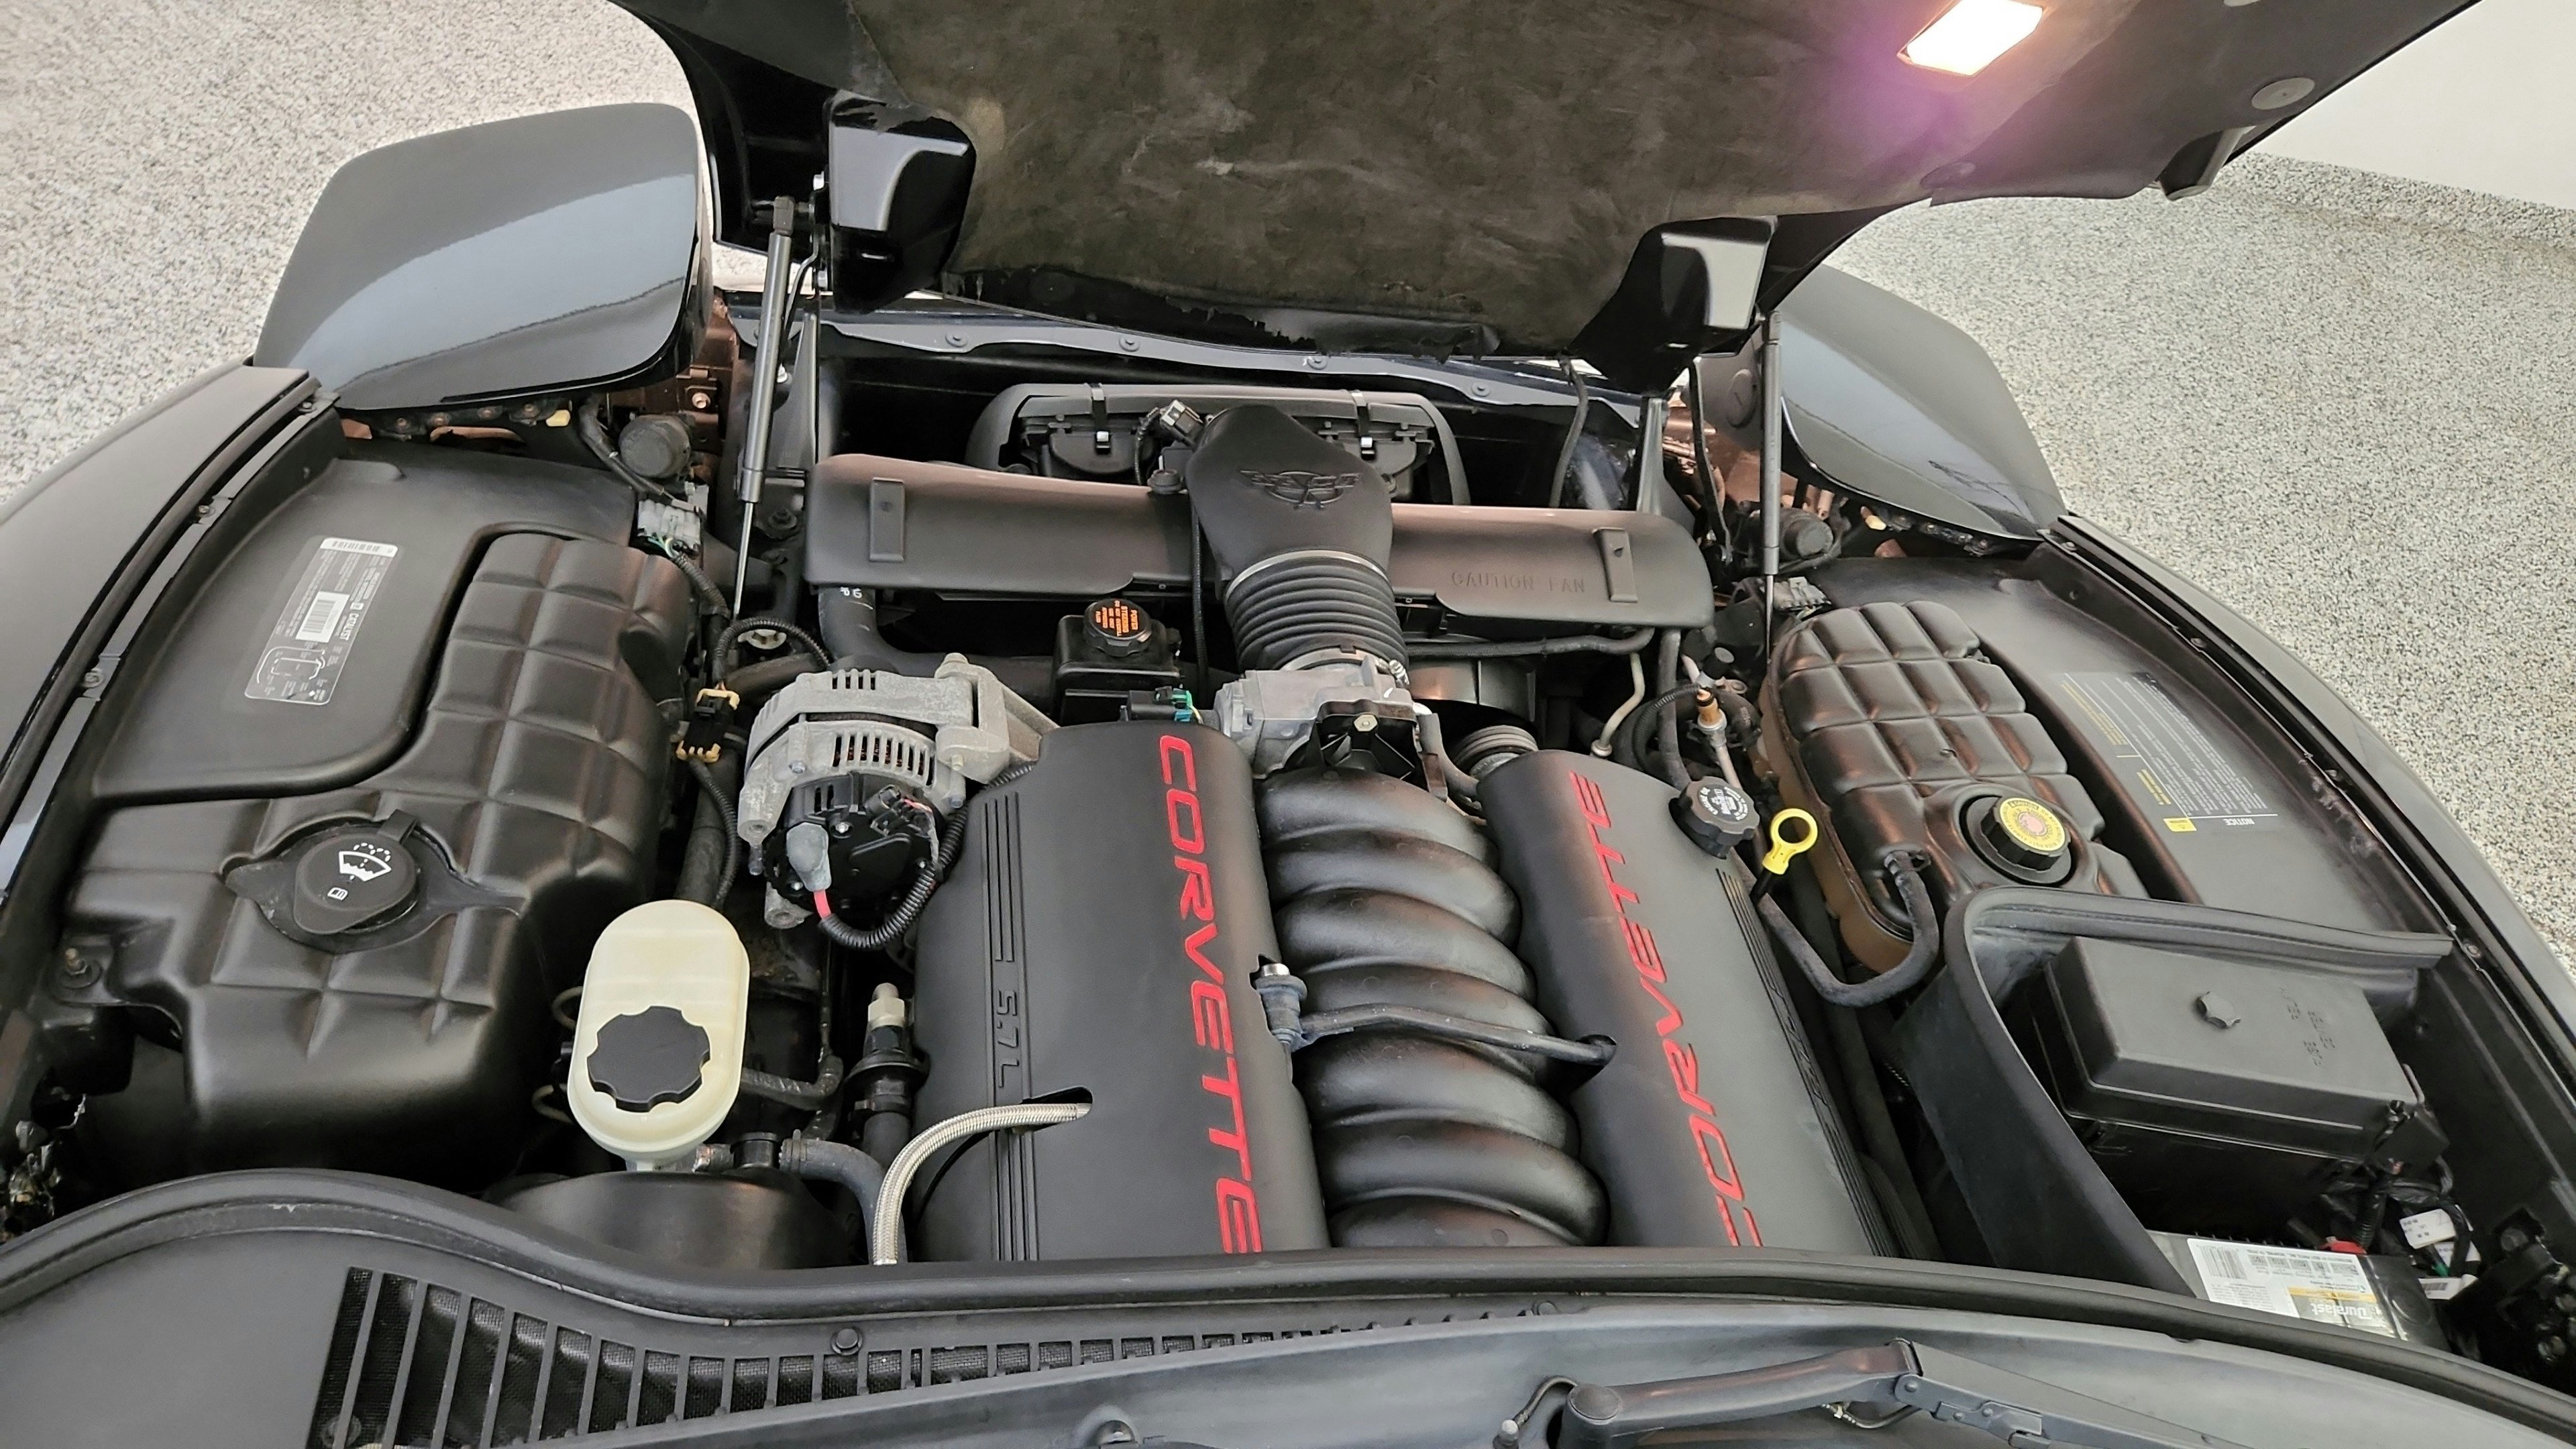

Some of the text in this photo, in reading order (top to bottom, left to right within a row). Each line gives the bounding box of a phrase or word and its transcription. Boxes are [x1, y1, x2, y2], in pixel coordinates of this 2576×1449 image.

[1451, 571, 1585, 593] CAUTION FAN
[339, 612, 360, 641] CATALYST
[1699, 794, 1719, 815] ENGINE
[2224, 818, 2255, 826] NOTICE
[1159, 734, 1263, 1253] CORVETTE
[996, 989, 1020, 1088] 5.7L
[2310, 1301, 2373, 1320] Duralast
